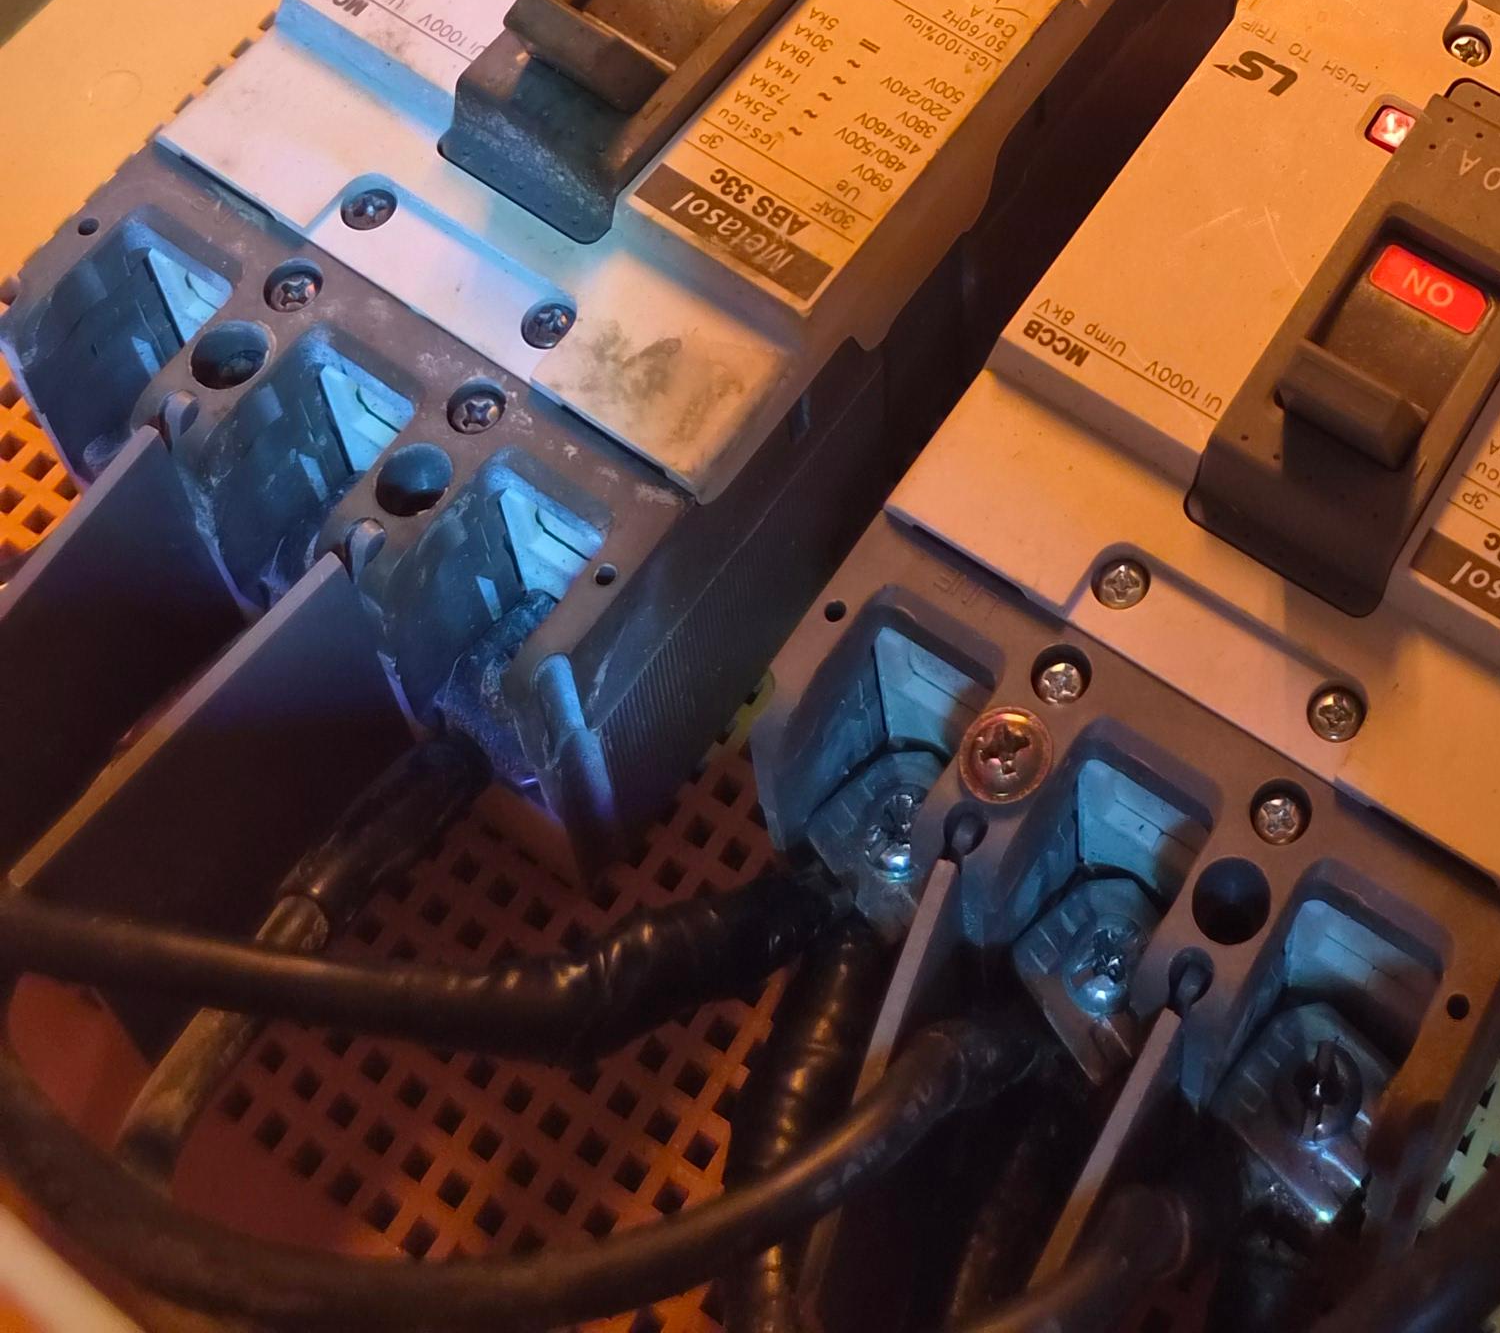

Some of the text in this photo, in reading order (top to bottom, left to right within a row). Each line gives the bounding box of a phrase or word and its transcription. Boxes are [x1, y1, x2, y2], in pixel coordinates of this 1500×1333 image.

[416, 13, 467, 48] 1000V
[793, 23, 834, 53] 30kA
[941, 8, 1011, 54] 50/60Hz
[764, 56, 801, 85] 14kA
[779, 40, 816, 68] 18kA
[808, 6, 966, 105] 500V 5kA
[1286, 40, 1313, 63] TO
[748, 73, 791, 106] 7.5kA
[1228, 49, 1297, 96] LS
[1320, 59, 1371, 94] PUSH
[733, 90, 778, 123] 2.5kA
[879, 76, 953, 123] 220/240V
[853, 112, 922, 156] 415/460V
[895, 110, 938, 140] 380V
[834, 126, 908, 173] 480/500V
[698, 133, 857, 231] 30AF 3P
[835, 178, 862, 203] Ue
[850, 163, 894, 193] 690V
[709, 167, 812, 237] ABS 33c
[669, 188, 795, 274] Metasol
[1401, 267, 1455, 308] ON
[1022, 319, 1091, 368] MCCB
[1035, 298, 1223, 414] Ui 1000V Uimp 8kV
[1461, 491, 1489, 511] 3P
